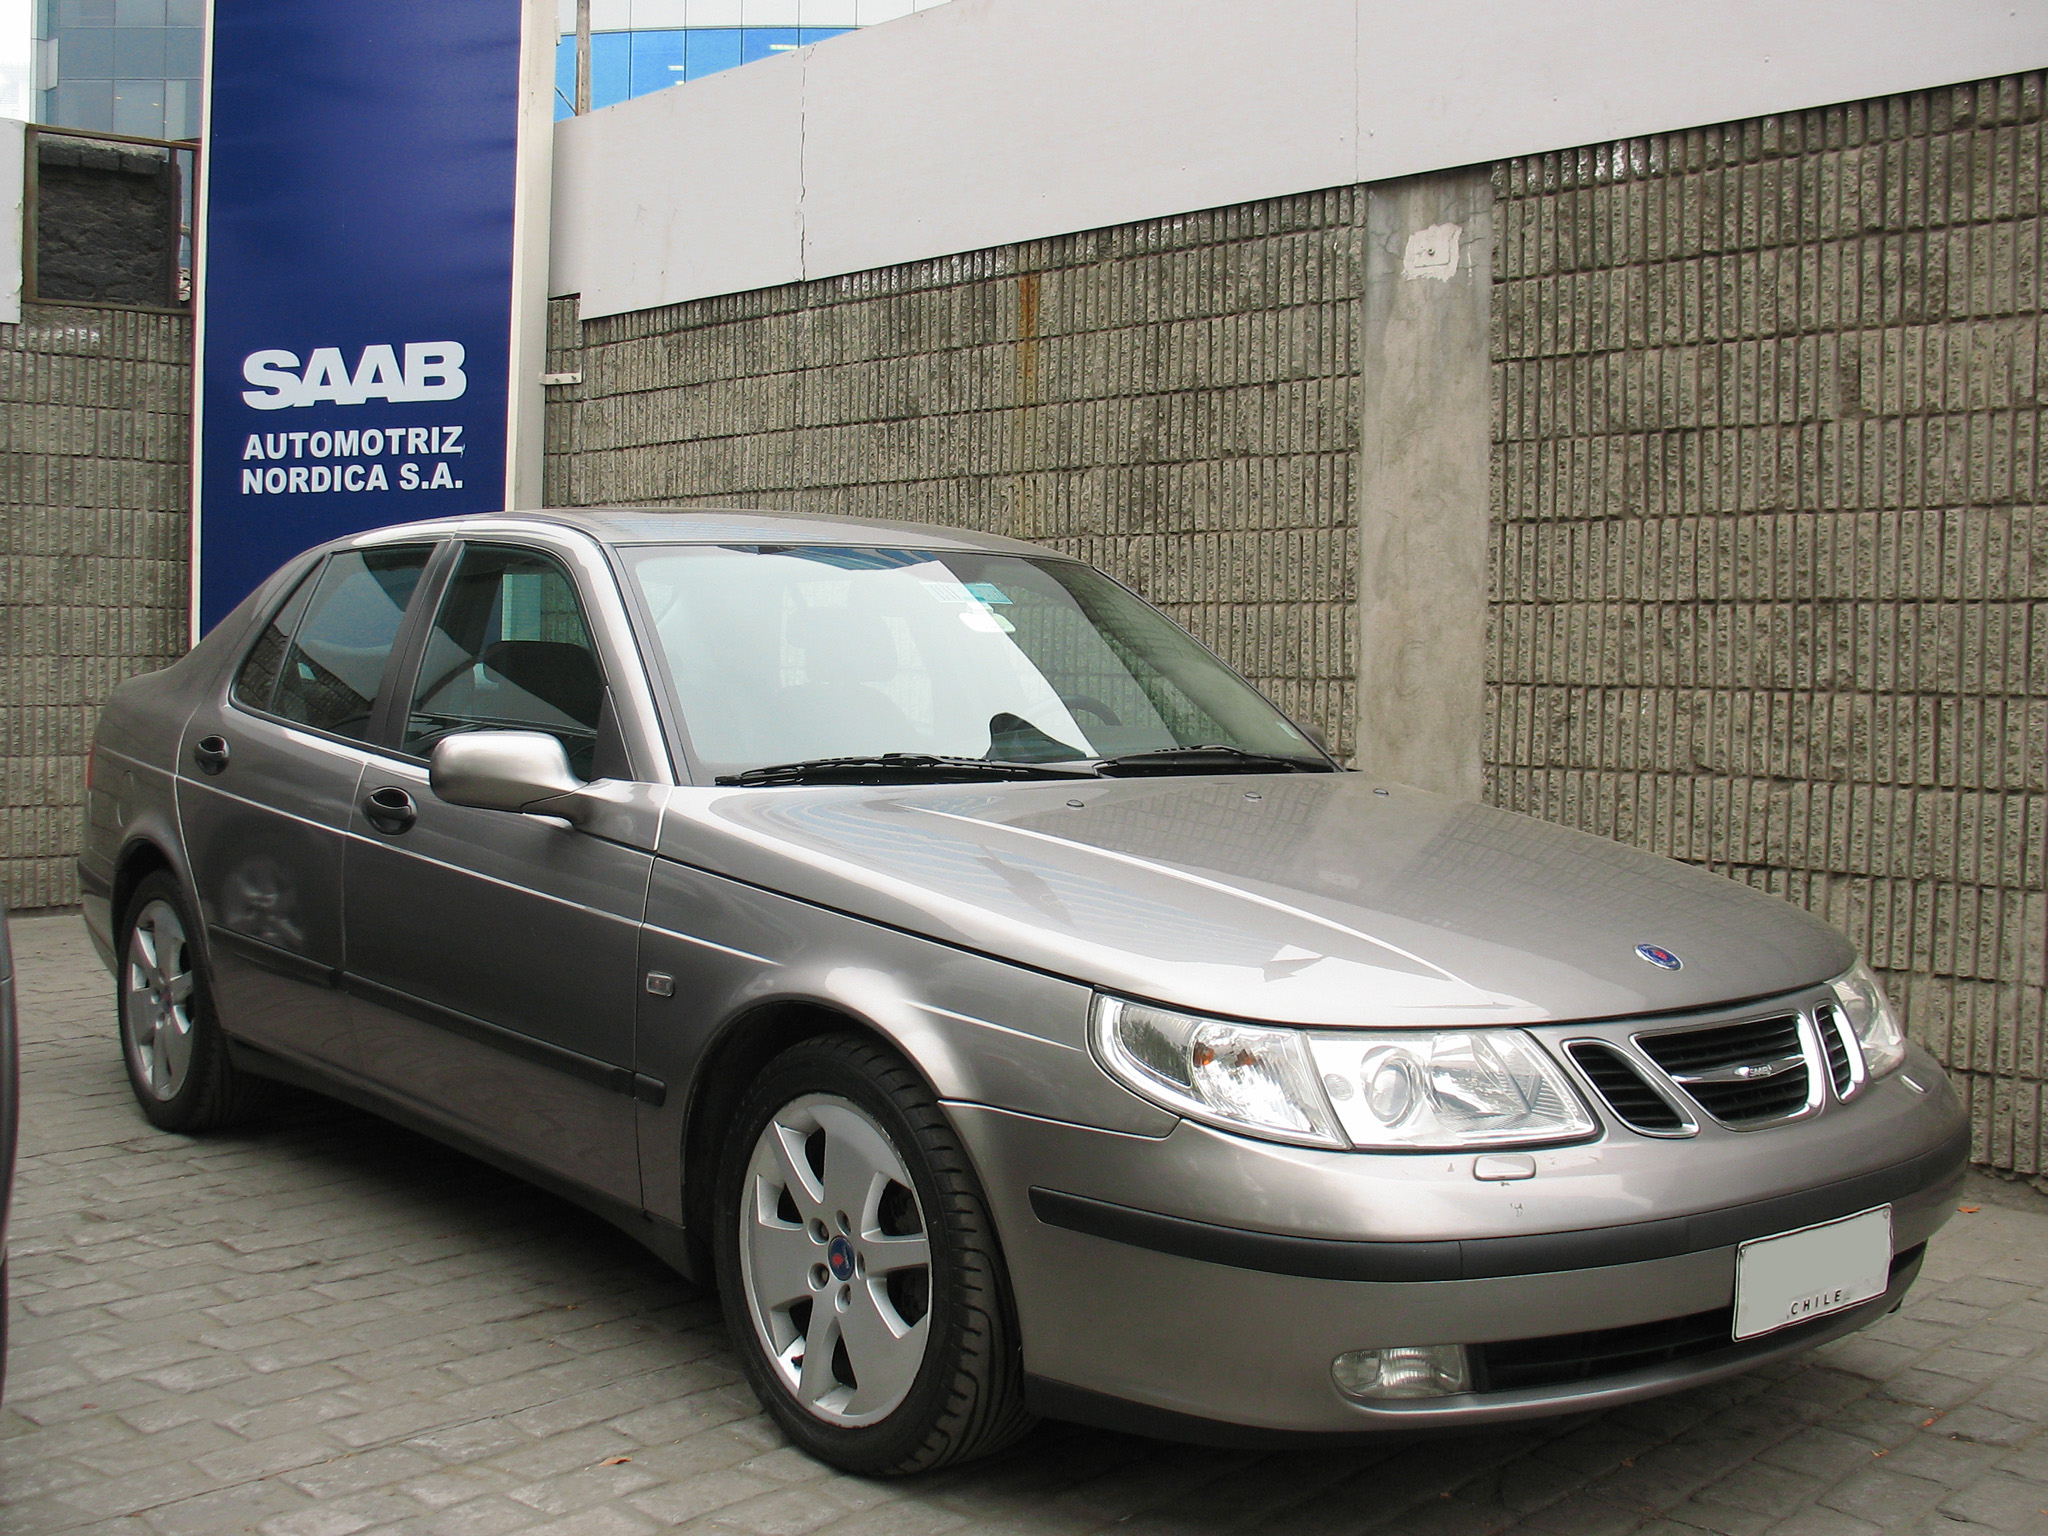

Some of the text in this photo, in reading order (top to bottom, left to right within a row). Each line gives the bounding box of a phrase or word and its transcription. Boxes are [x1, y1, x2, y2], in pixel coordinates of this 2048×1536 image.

[242, 341, 467, 410] SAAB
[243, 426, 464, 460] AUTOMOTRIZ
[242, 462, 463, 494] NORDICA S.A.
[1790, 1290, 1841, 1315] CHILE
